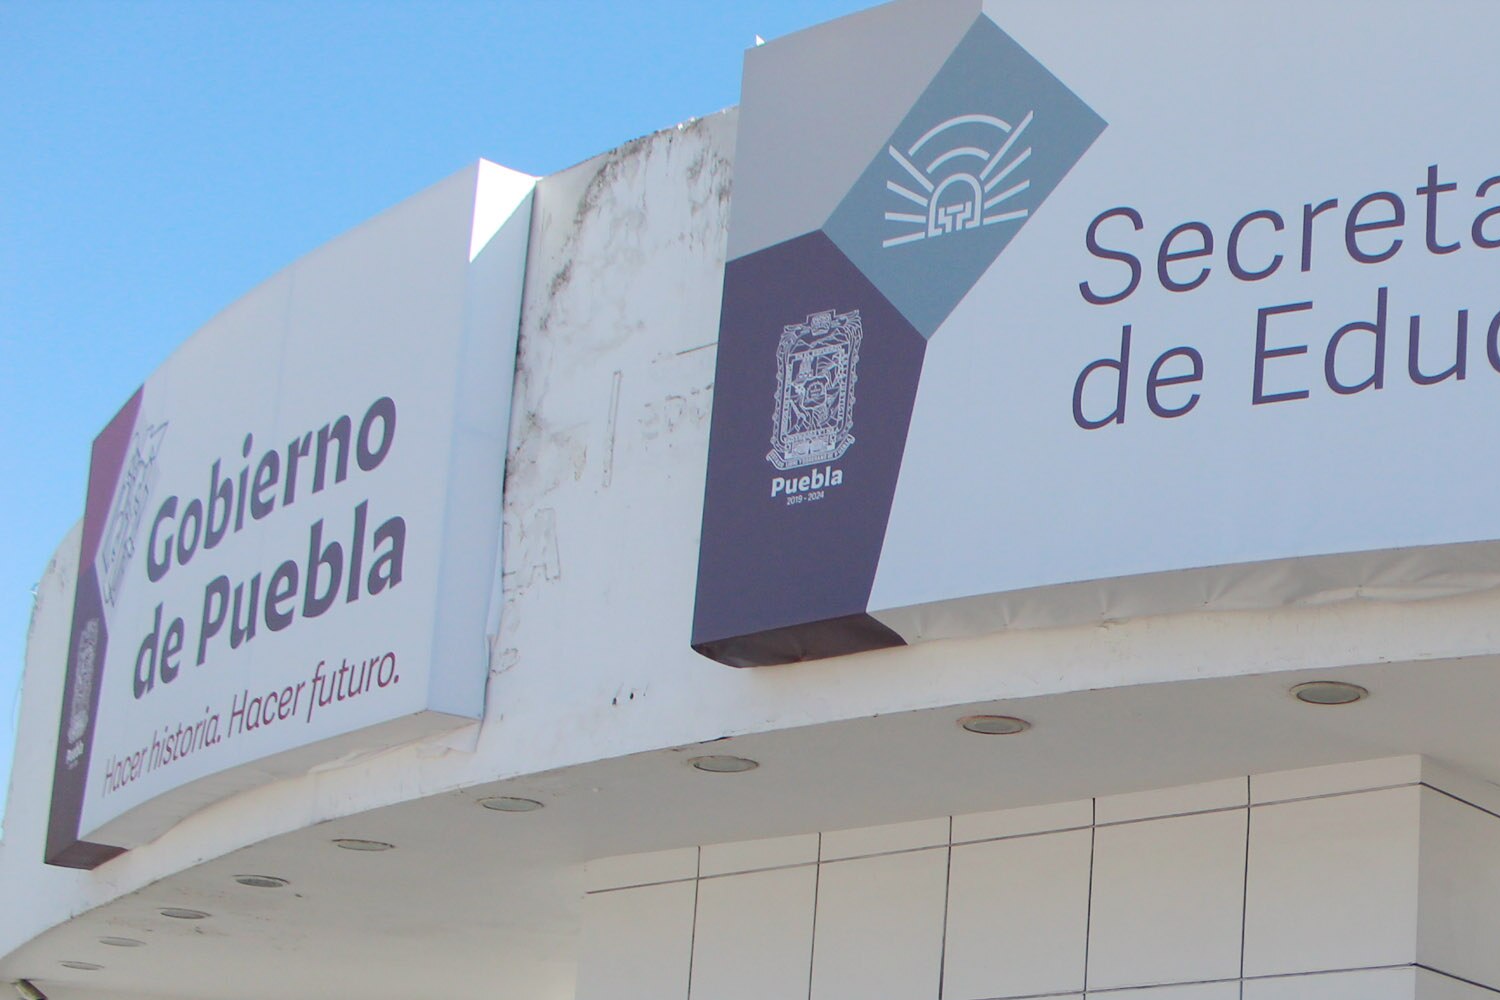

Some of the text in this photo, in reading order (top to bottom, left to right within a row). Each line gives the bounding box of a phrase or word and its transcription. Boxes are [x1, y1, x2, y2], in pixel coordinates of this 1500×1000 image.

[1072, 324, 1205, 431] de
[146, 396, 397, 583] Gobierno
[770, 466, 843, 498] Puebla
[133, 601, 185, 700] de
[196, 498, 407, 667] Puebla
[102, 651, 400, 798] Hacer historia. Hacer futuro.
